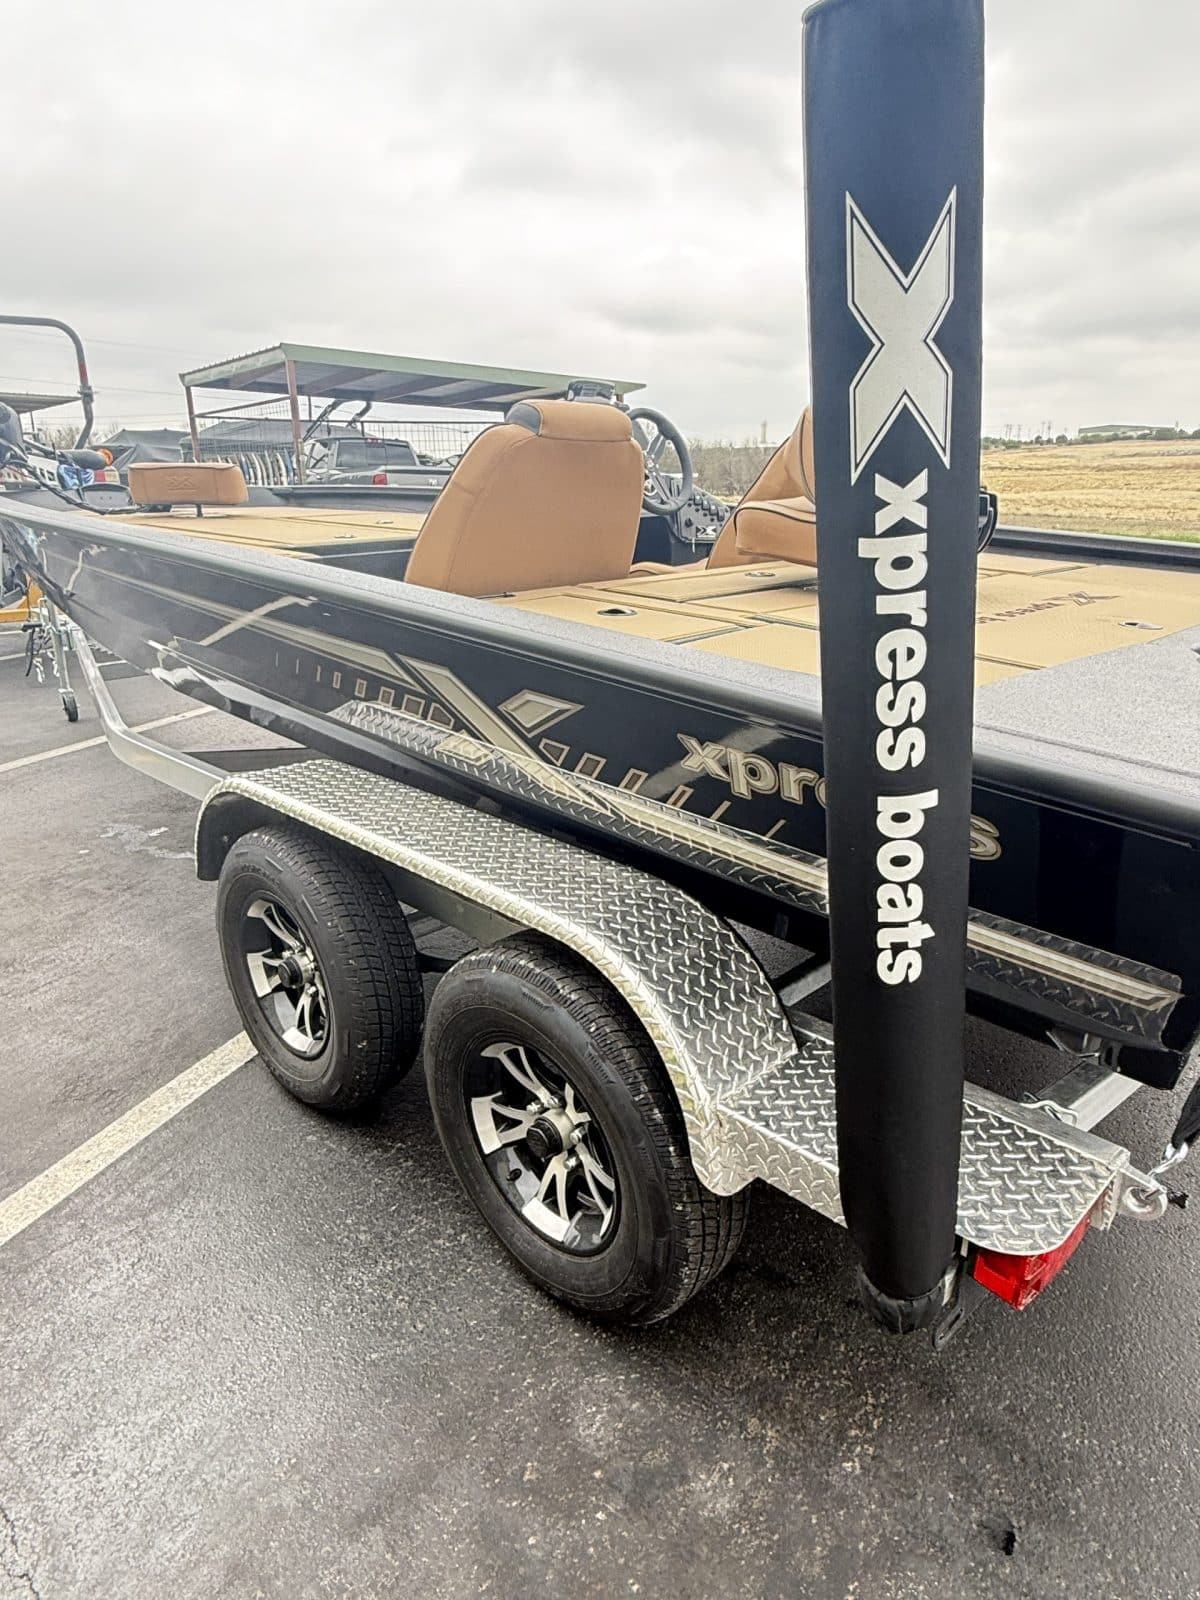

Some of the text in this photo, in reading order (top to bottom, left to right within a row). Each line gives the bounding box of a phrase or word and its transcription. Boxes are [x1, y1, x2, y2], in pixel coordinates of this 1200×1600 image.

[677, 733, 1002, 861] xprs
[858, 467, 939, 985] xpress boats
